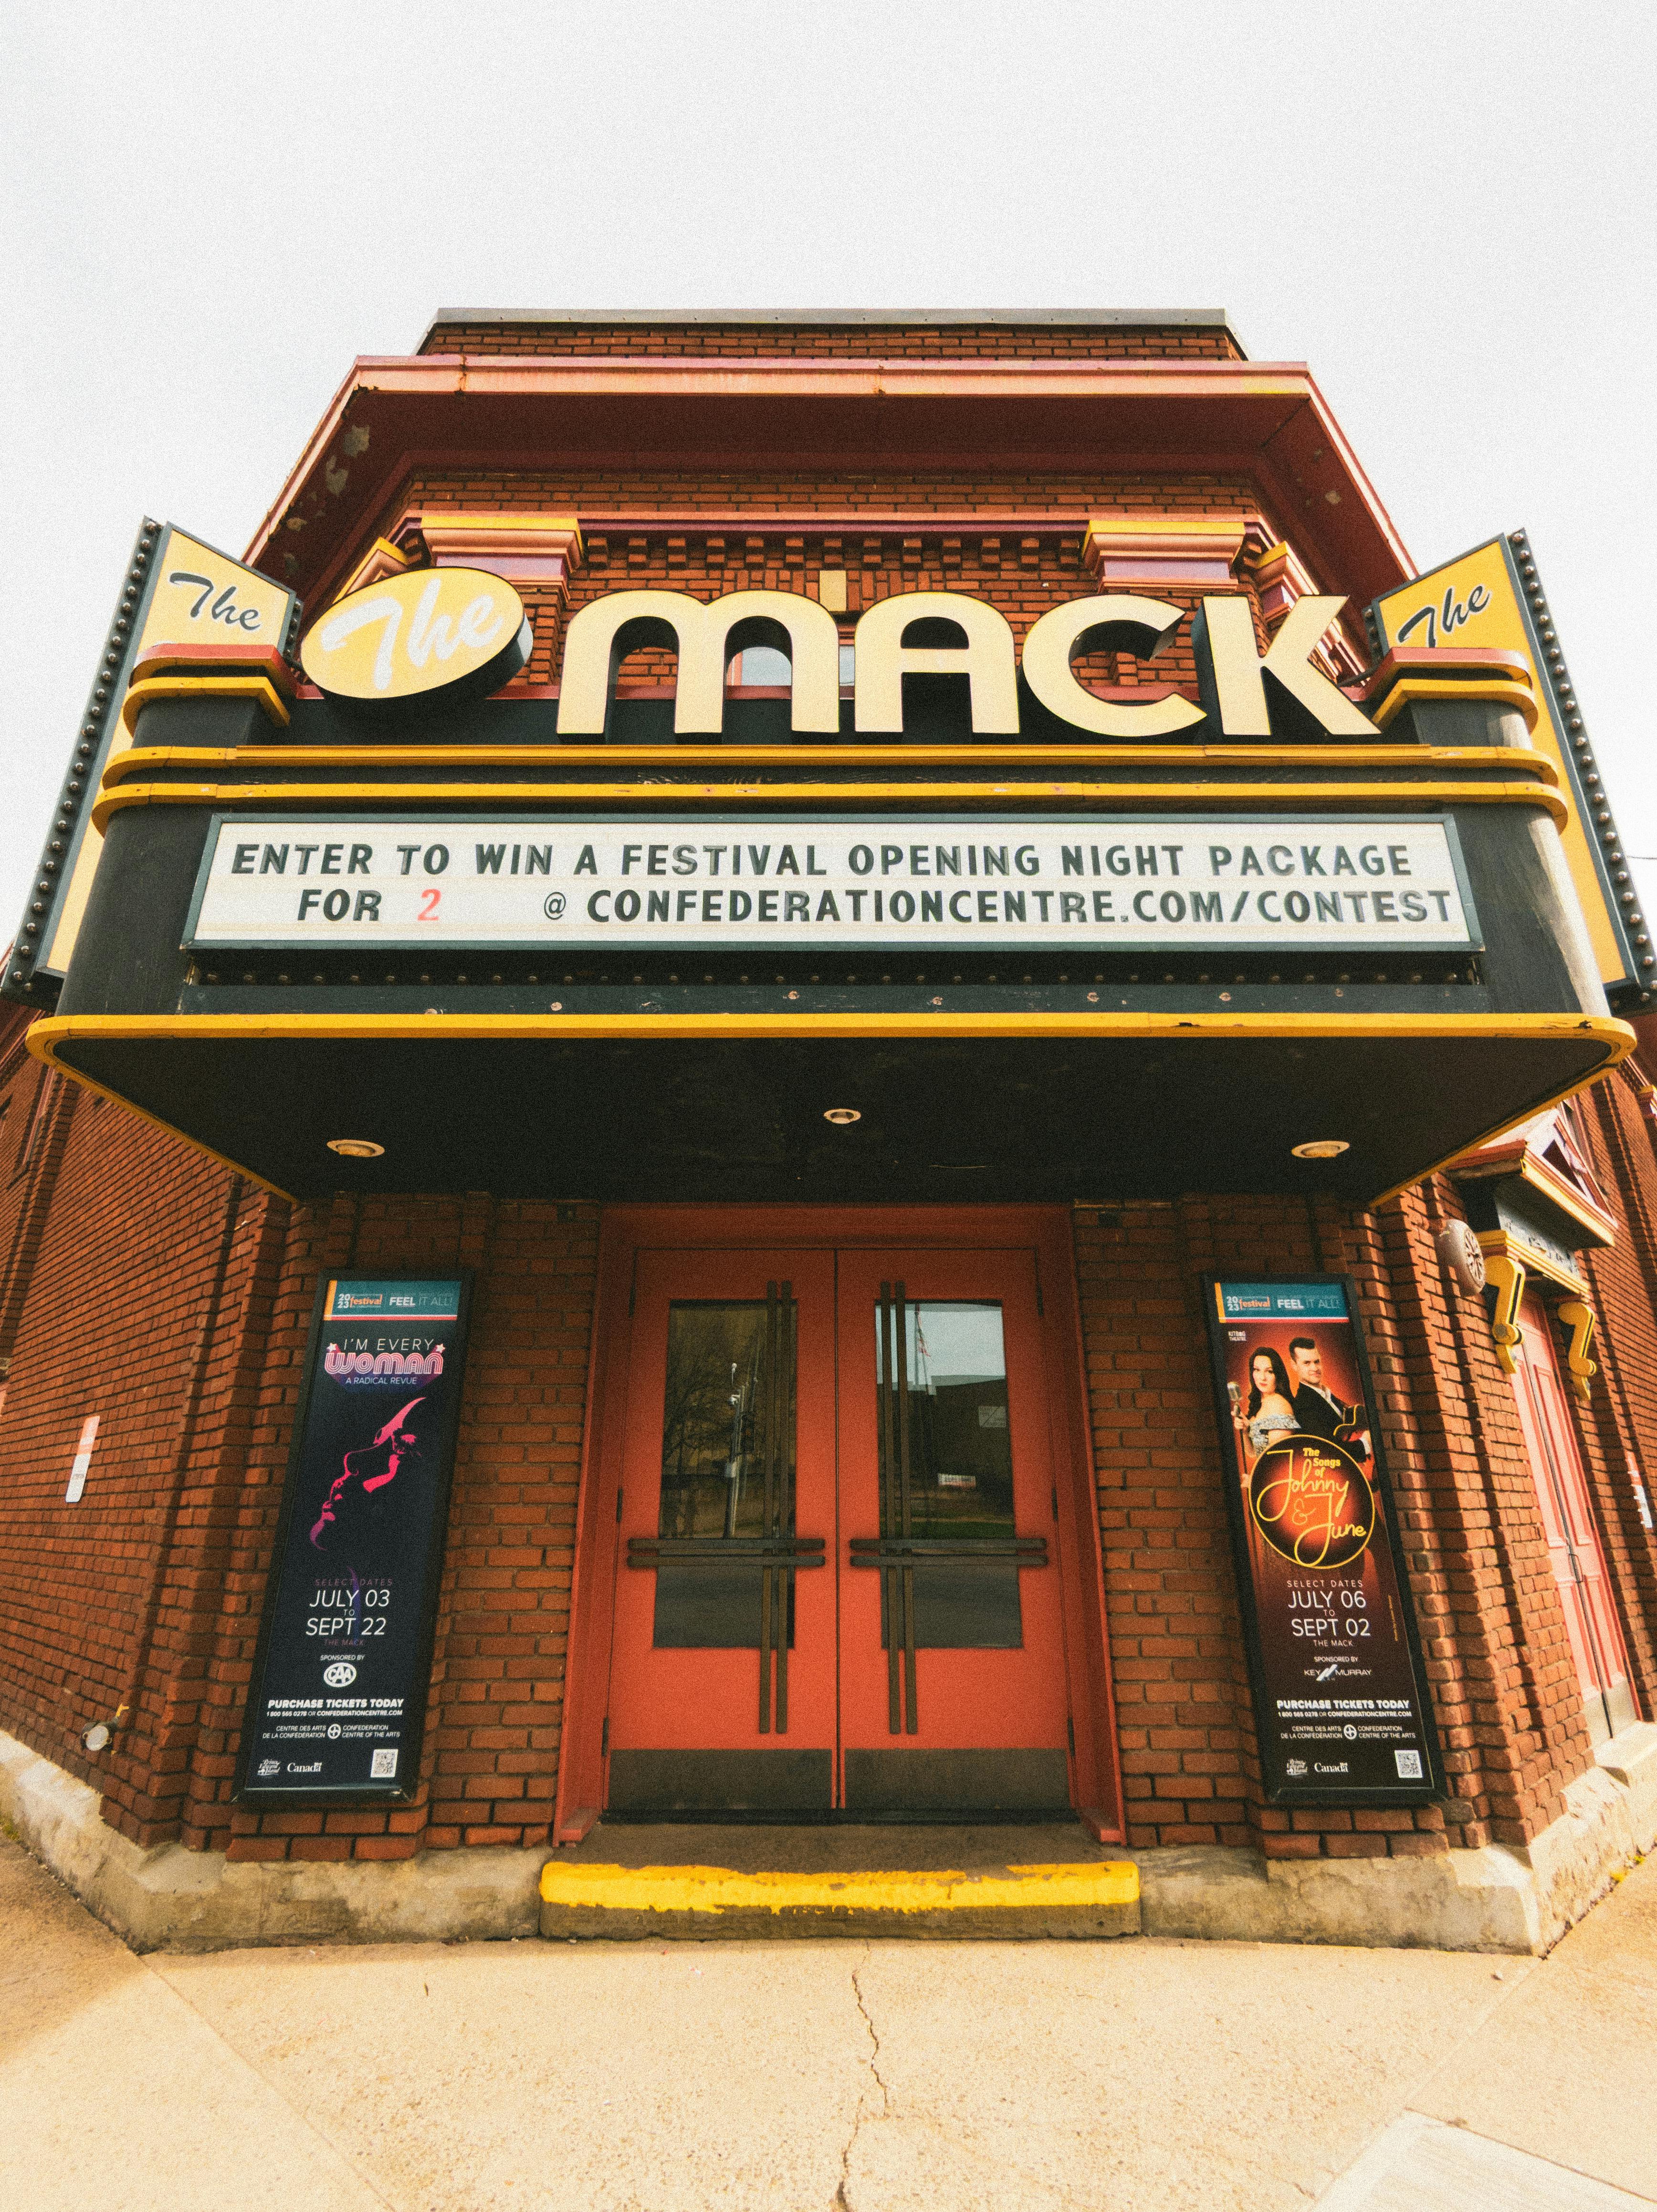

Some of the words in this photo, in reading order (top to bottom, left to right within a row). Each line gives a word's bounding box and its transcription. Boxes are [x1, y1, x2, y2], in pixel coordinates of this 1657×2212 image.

[169, 572, 262, 631] The
[1398, 585, 1490, 648] The
[320, 578, 506, 690] The
[556, 590, 1382, 737] MACK
[231, 844, 374, 875] ENTER
[397, 844, 449, 875] TO
[476, 844, 552, 875] WIN
[574, 844, 598, 875] A
[621, 845, 827, 875] FESTIVAL
[848, 845, 1040, 876] OPENING
[1062, 845, 1183, 876] NIGHT
[1209, 845, 1411, 876] PACKAGE
[297, 889, 382, 921] FOR
[417, 888, 441, 921] 2
[544, 892, 566, 921] @
[587, 889, 1451, 923] CONFEDERATIONCENTRE.COM/CONTEST
[350, 1294, 382, 1308] festival
[389, 1297, 416, 1306] FEEL
[419, 1297, 428, 1305] IT
[1239, 1296, 1270, 1309] festival
[1277, 1299, 1304, 1308] FEEL
[378, 1339, 434, 1350] EVERY
[1303, 1448, 1320, 1456] The
[1313, 1458, 1341, 1469] Songs
[1315, 1467, 1326, 1478] of
[1257, 1450, 1349, 1522] Johnny
[1292, 1498, 1316, 1525] &
[1294, 1493, 1366, 1566] June
[360, 1578, 393, 1586] DATES
[309, 1590, 359, 1607] JULY
[366, 1589, 390, 1607] 03
[1288, 1591, 1333, 1608] JULY
[1341, 1590, 1366, 1608] 06
[306, 1617, 356, 1635] SEPT
[361, 1617, 386, 1635] 22
[1291, 1618, 1339, 1636] SEPT
[1346, 1618, 1371, 1636] 02
[326, 1664, 353, 1684] CAA
[268, 1699, 324, 1708] PURCHASE
[326, 1699, 367, 1708] TICKETS
[370, 1699, 404, 1708] TODAY
[1277, 1700, 1331, 1709] PURCHASE
[1333, 1700, 1374, 1709] TICKETS
[1376, 1700, 1409, 1709] TODAY
[287, 1763, 322, 1772] Canada
[1314, 1762, 1348, 1772] Canada
